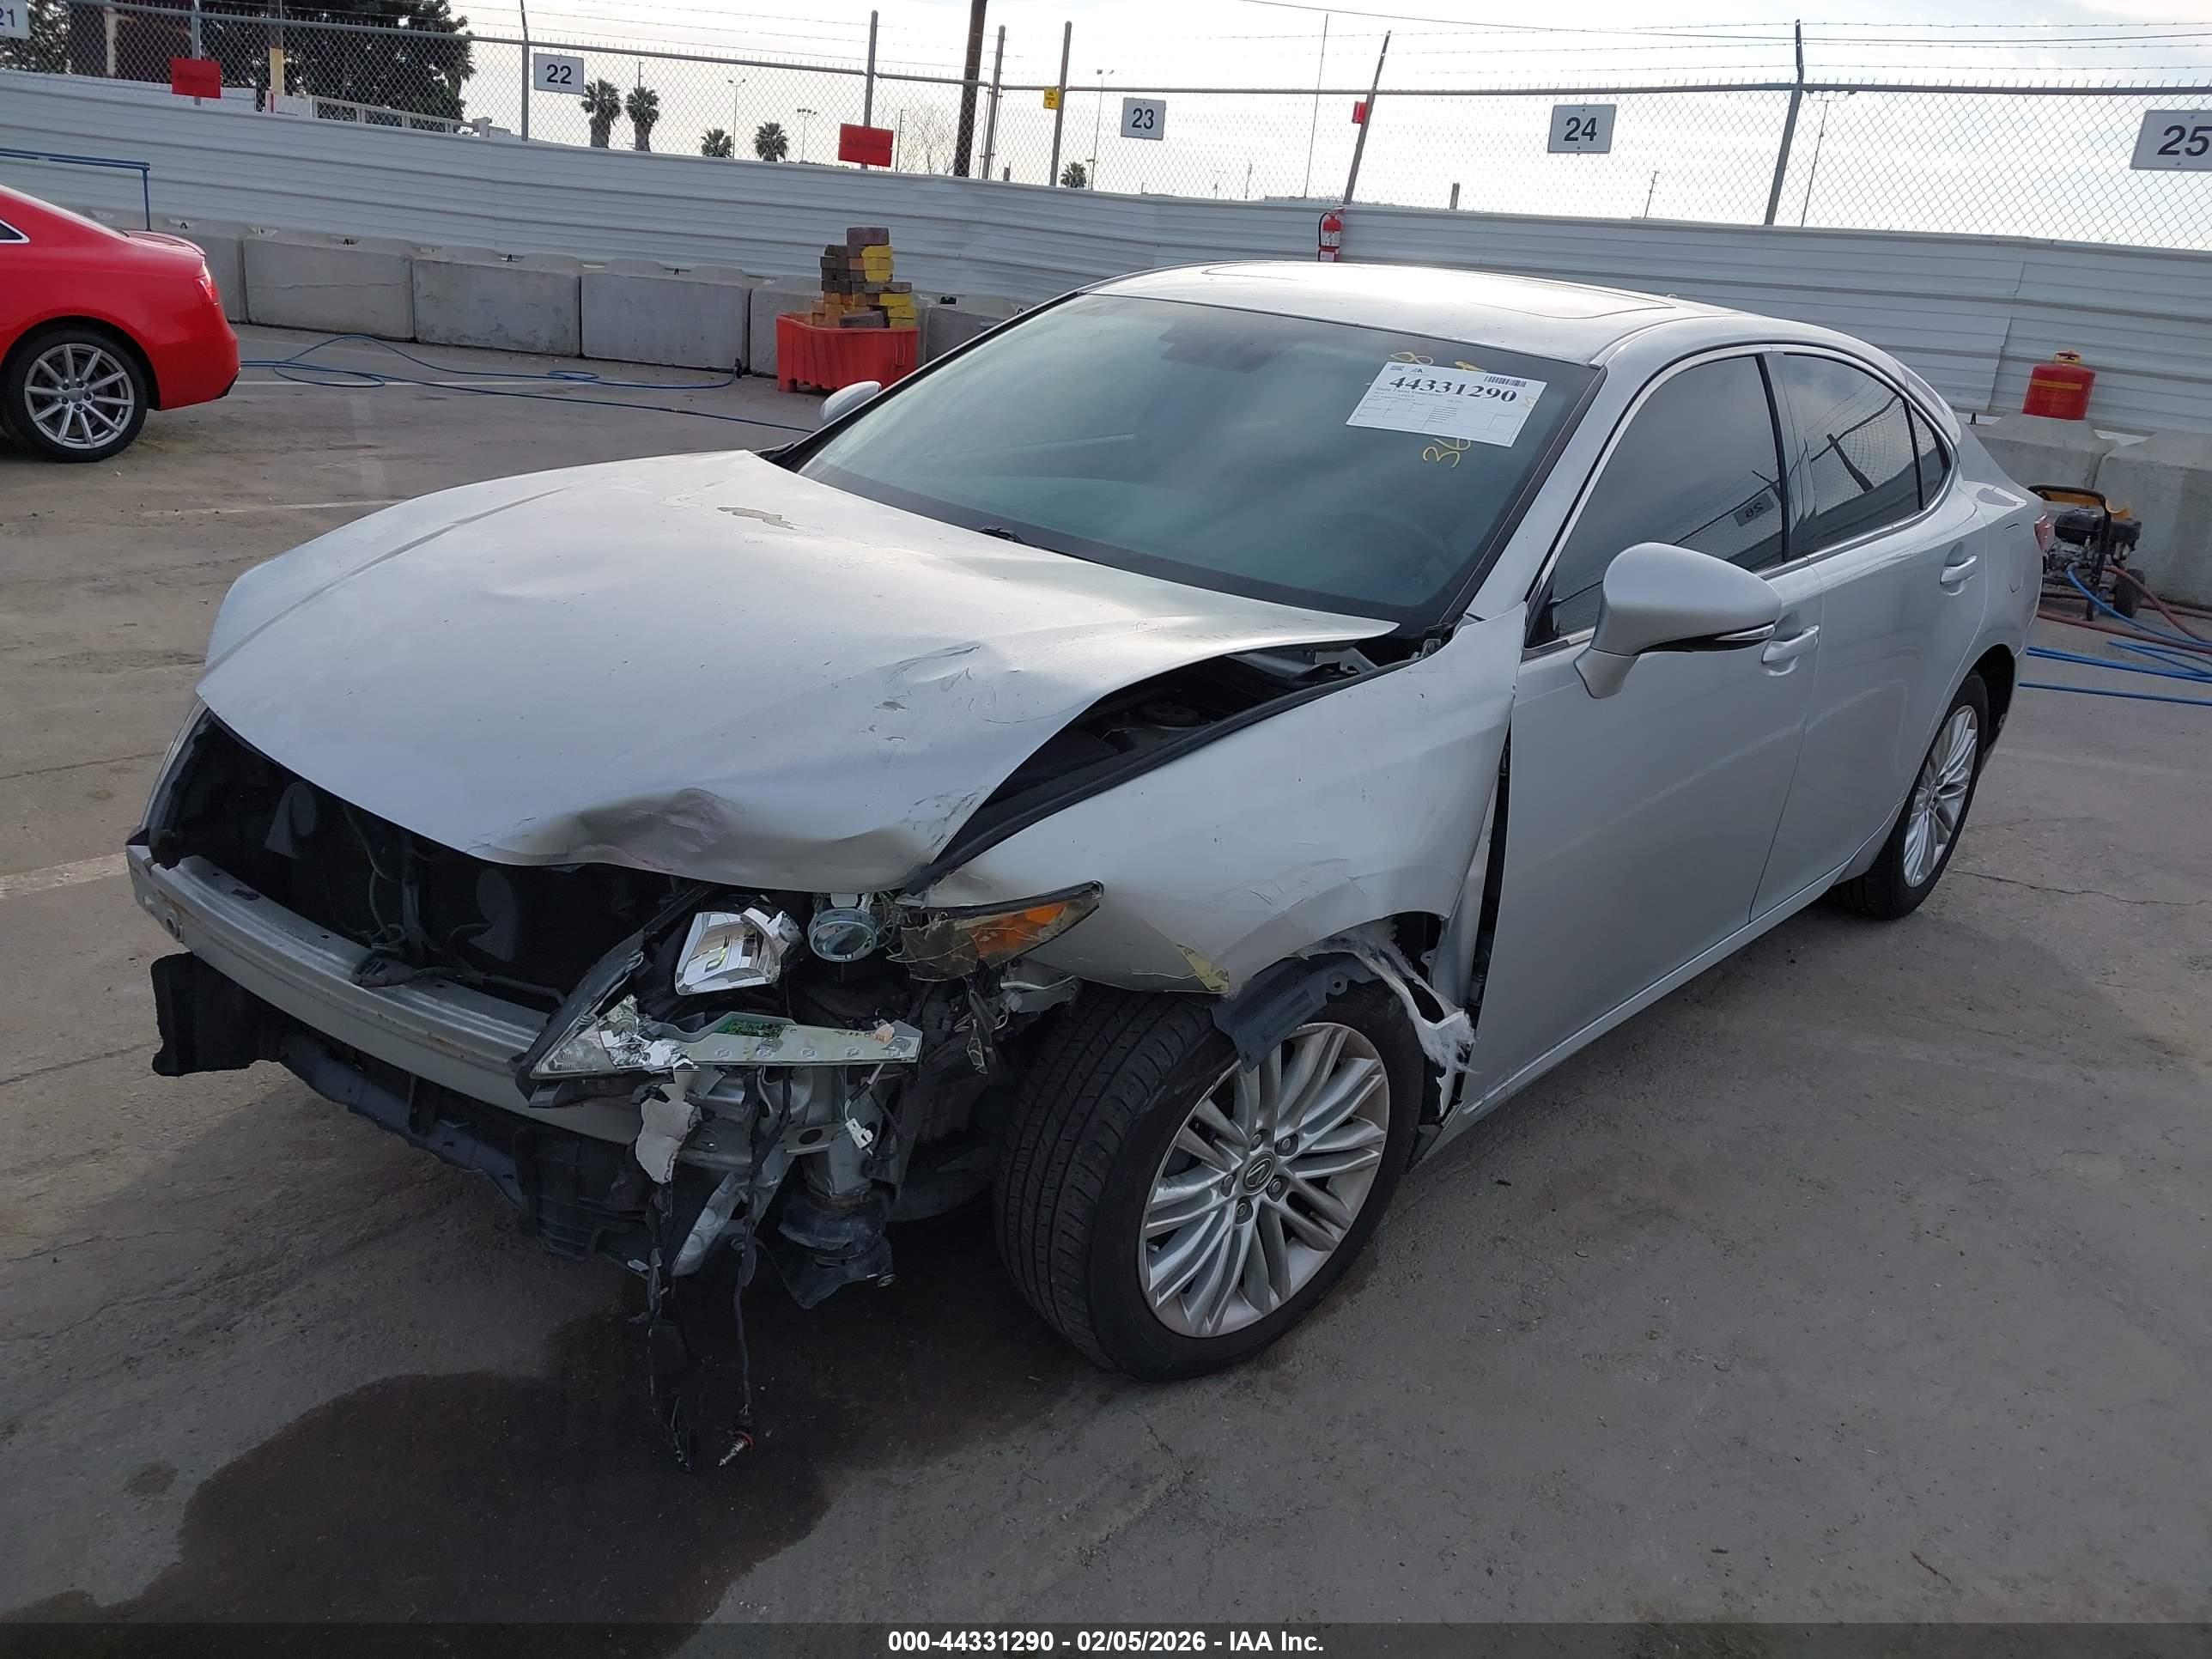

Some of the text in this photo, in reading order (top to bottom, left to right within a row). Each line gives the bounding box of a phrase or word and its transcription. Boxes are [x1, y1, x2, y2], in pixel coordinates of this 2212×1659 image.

[546, 64, 572, 85] 22
[1132, 107, 1154, 130] 23
[1563, 117, 1597, 142] 24
[2157, 125, 2212, 157] 25
[1389, 376, 1517, 403] 44331290
